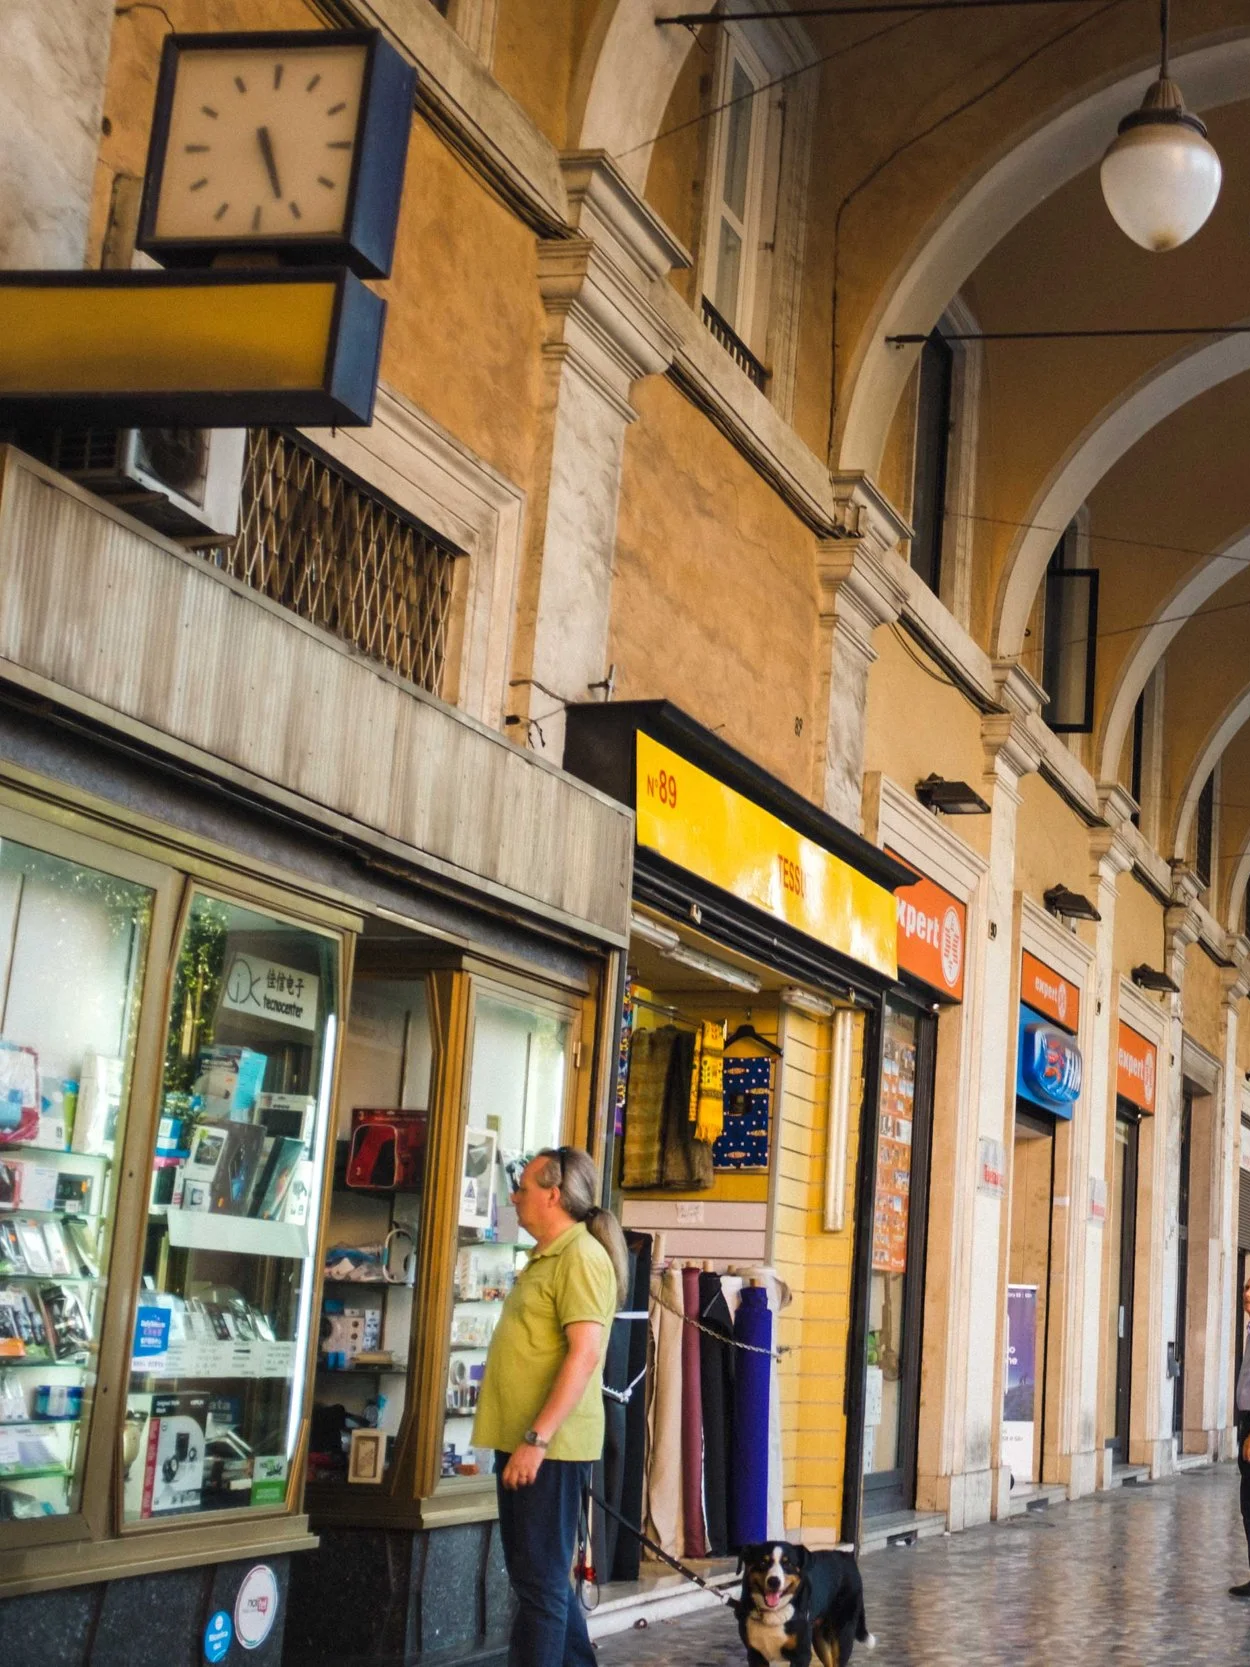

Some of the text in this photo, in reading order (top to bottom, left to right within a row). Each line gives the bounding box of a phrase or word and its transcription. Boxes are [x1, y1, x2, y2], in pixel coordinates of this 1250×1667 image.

[1035, 976, 1058, 1002] expert
[1064, 1047, 1082, 1092] TIM
[1118, 1047, 1144, 1080] expert
